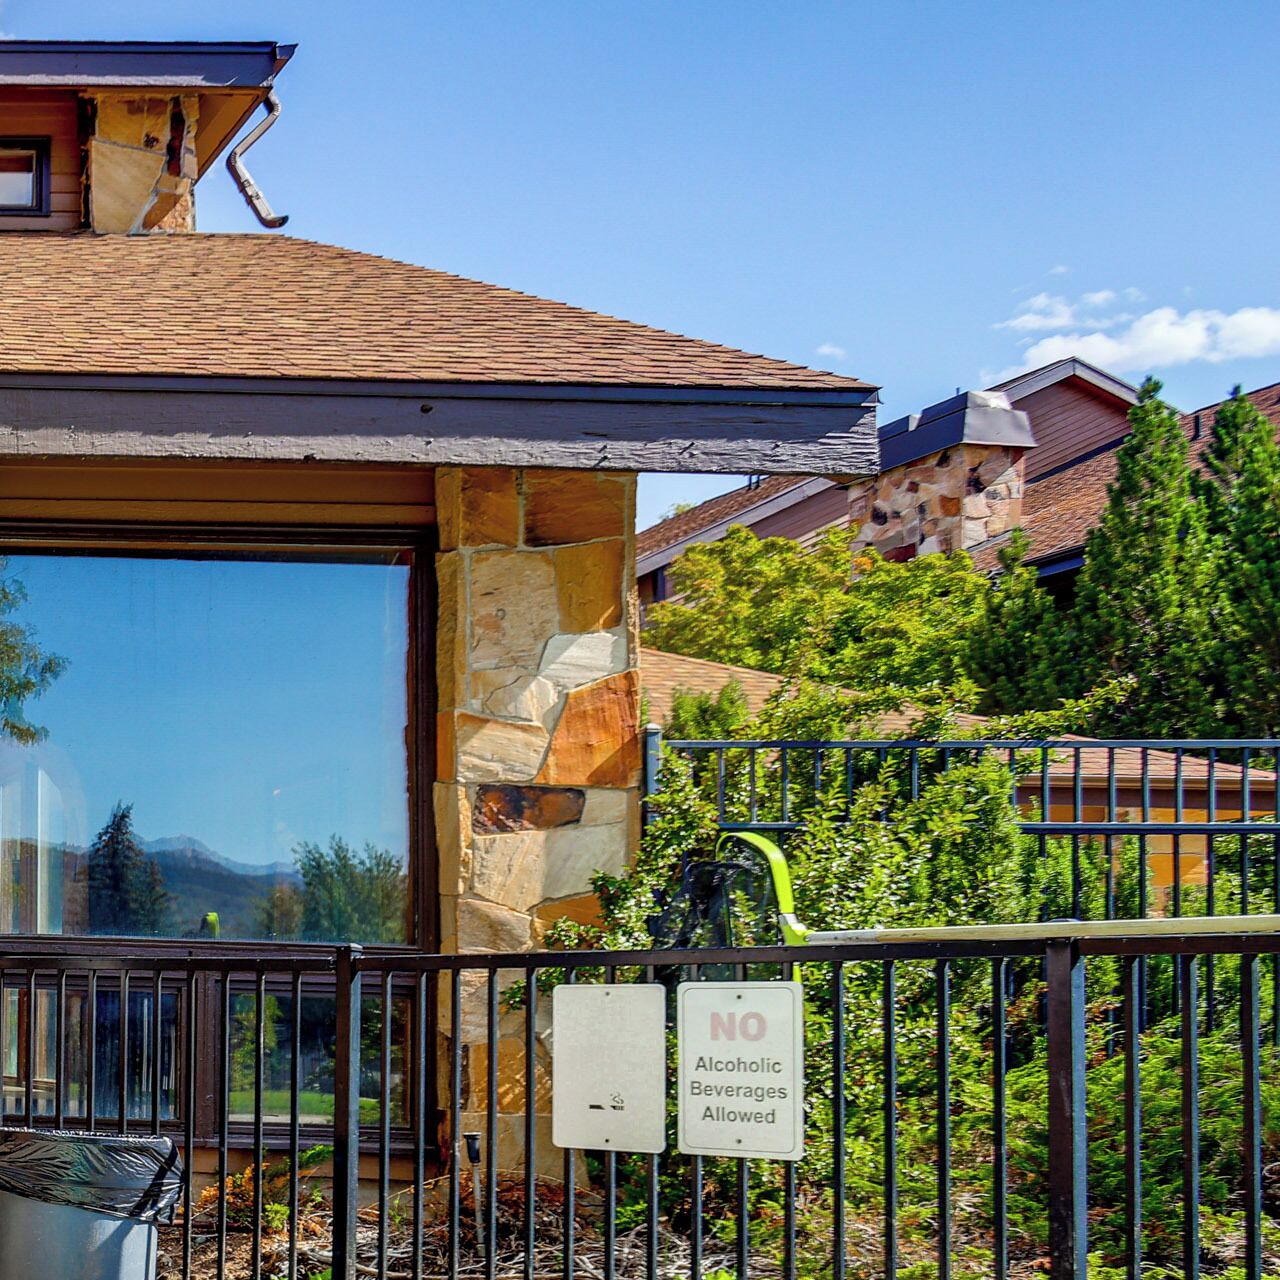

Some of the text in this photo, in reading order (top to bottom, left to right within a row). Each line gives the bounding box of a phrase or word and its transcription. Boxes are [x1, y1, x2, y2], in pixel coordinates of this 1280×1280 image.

[709, 1011, 768, 1042] NO
[694, 1056, 782, 1074] Alcoholic
[690, 1080, 788, 1102] Beverages
[701, 1106, 776, 1124] Allowed
